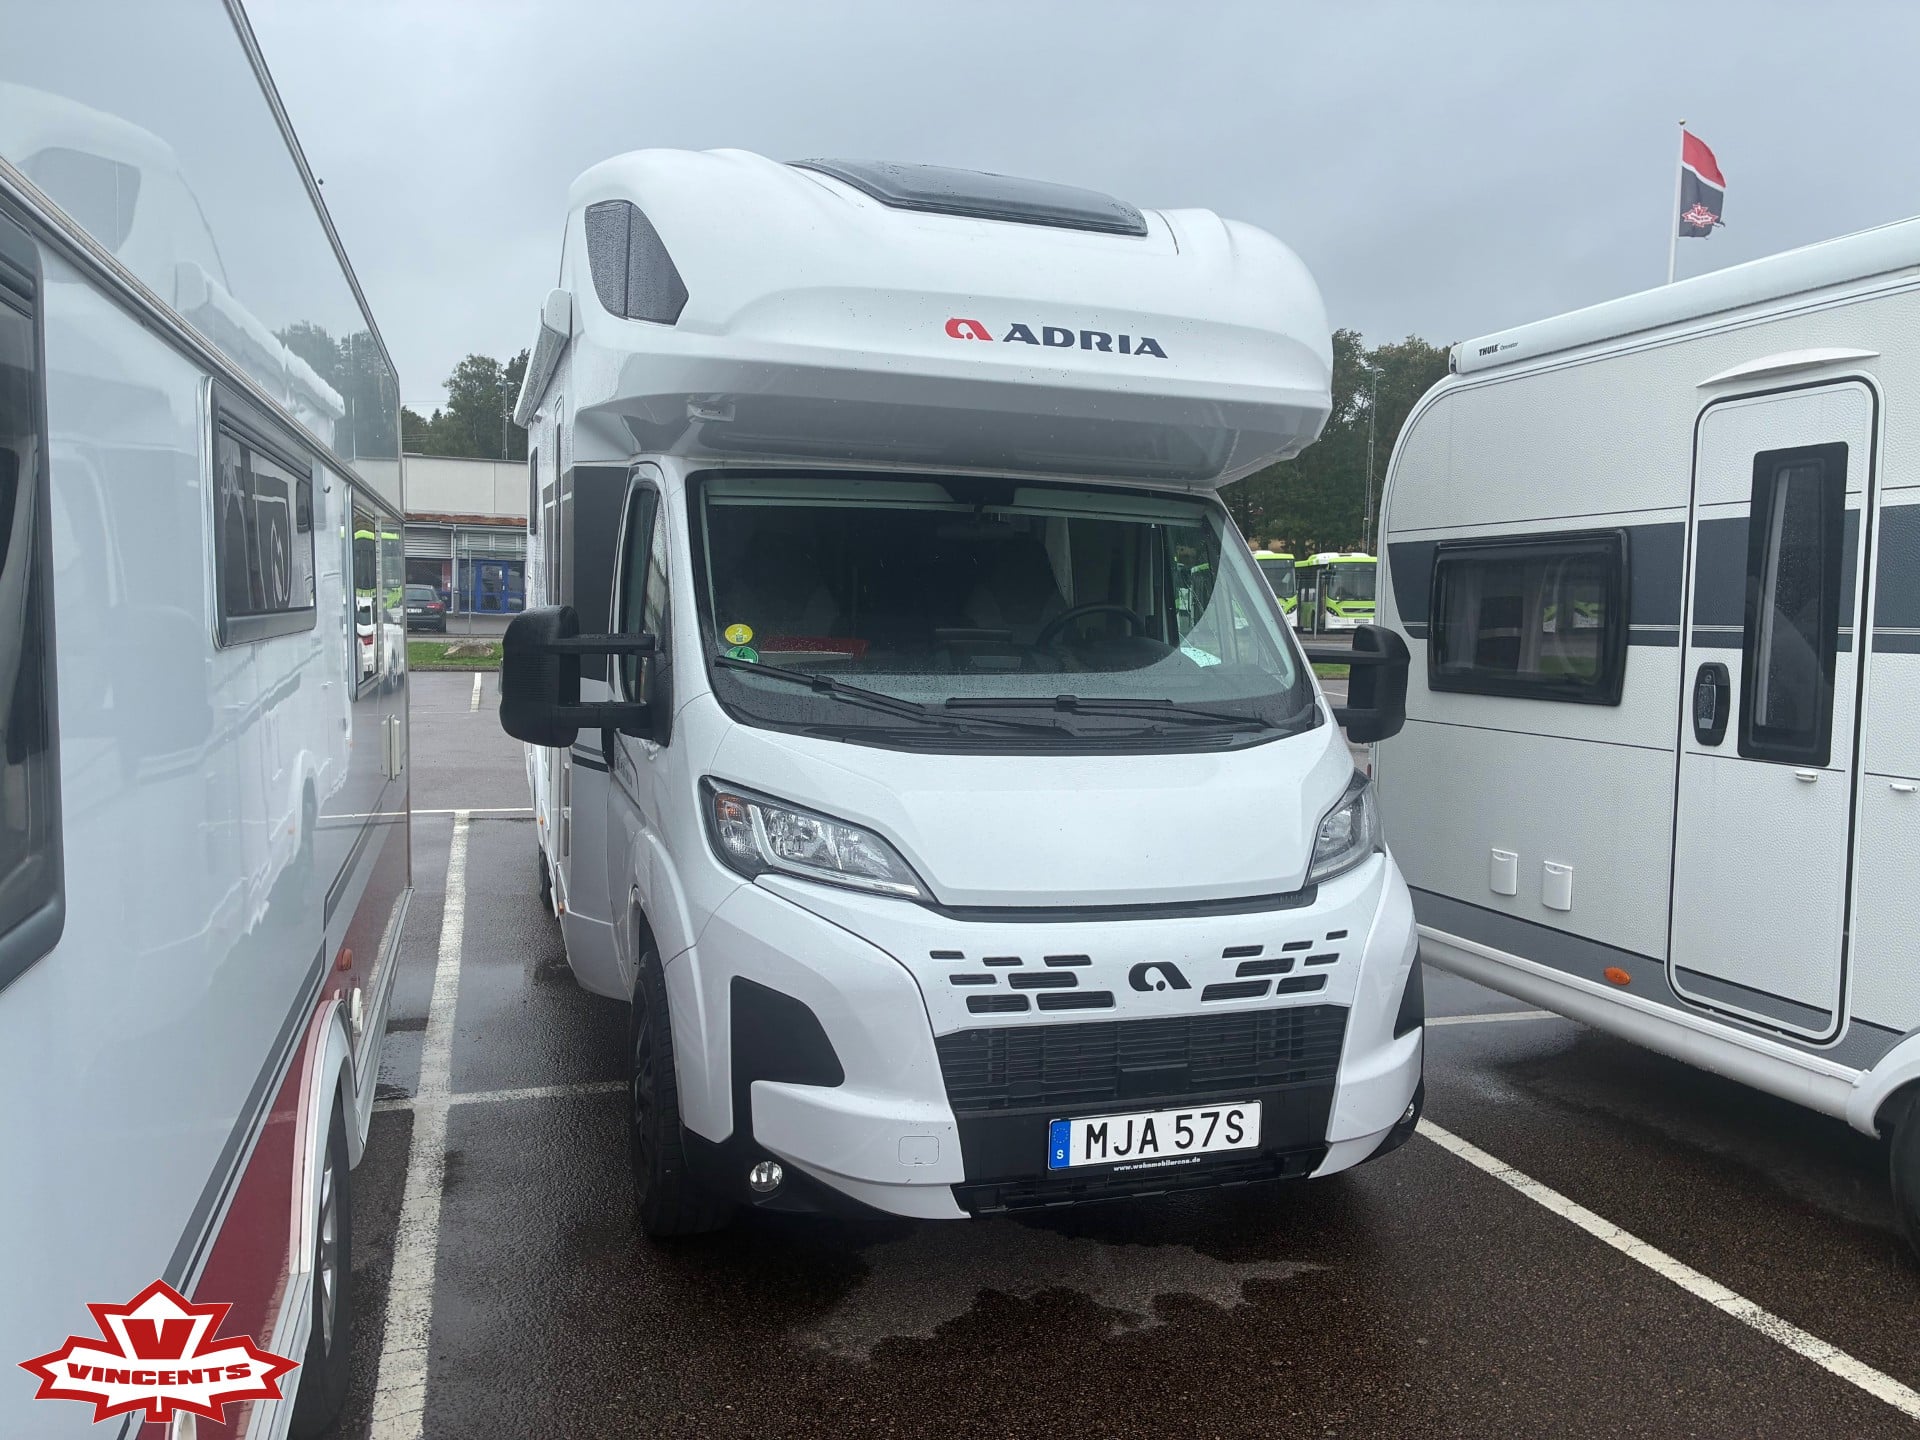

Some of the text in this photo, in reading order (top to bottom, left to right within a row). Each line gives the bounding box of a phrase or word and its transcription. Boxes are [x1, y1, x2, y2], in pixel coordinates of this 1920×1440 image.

[1002, 322, 1169, 359] ADRIA
[1479, 343, 1499, 357] THULE
[736, 647, 746, 659] 4
[1056, 1109, 1245, 1160] S MJA 57S
